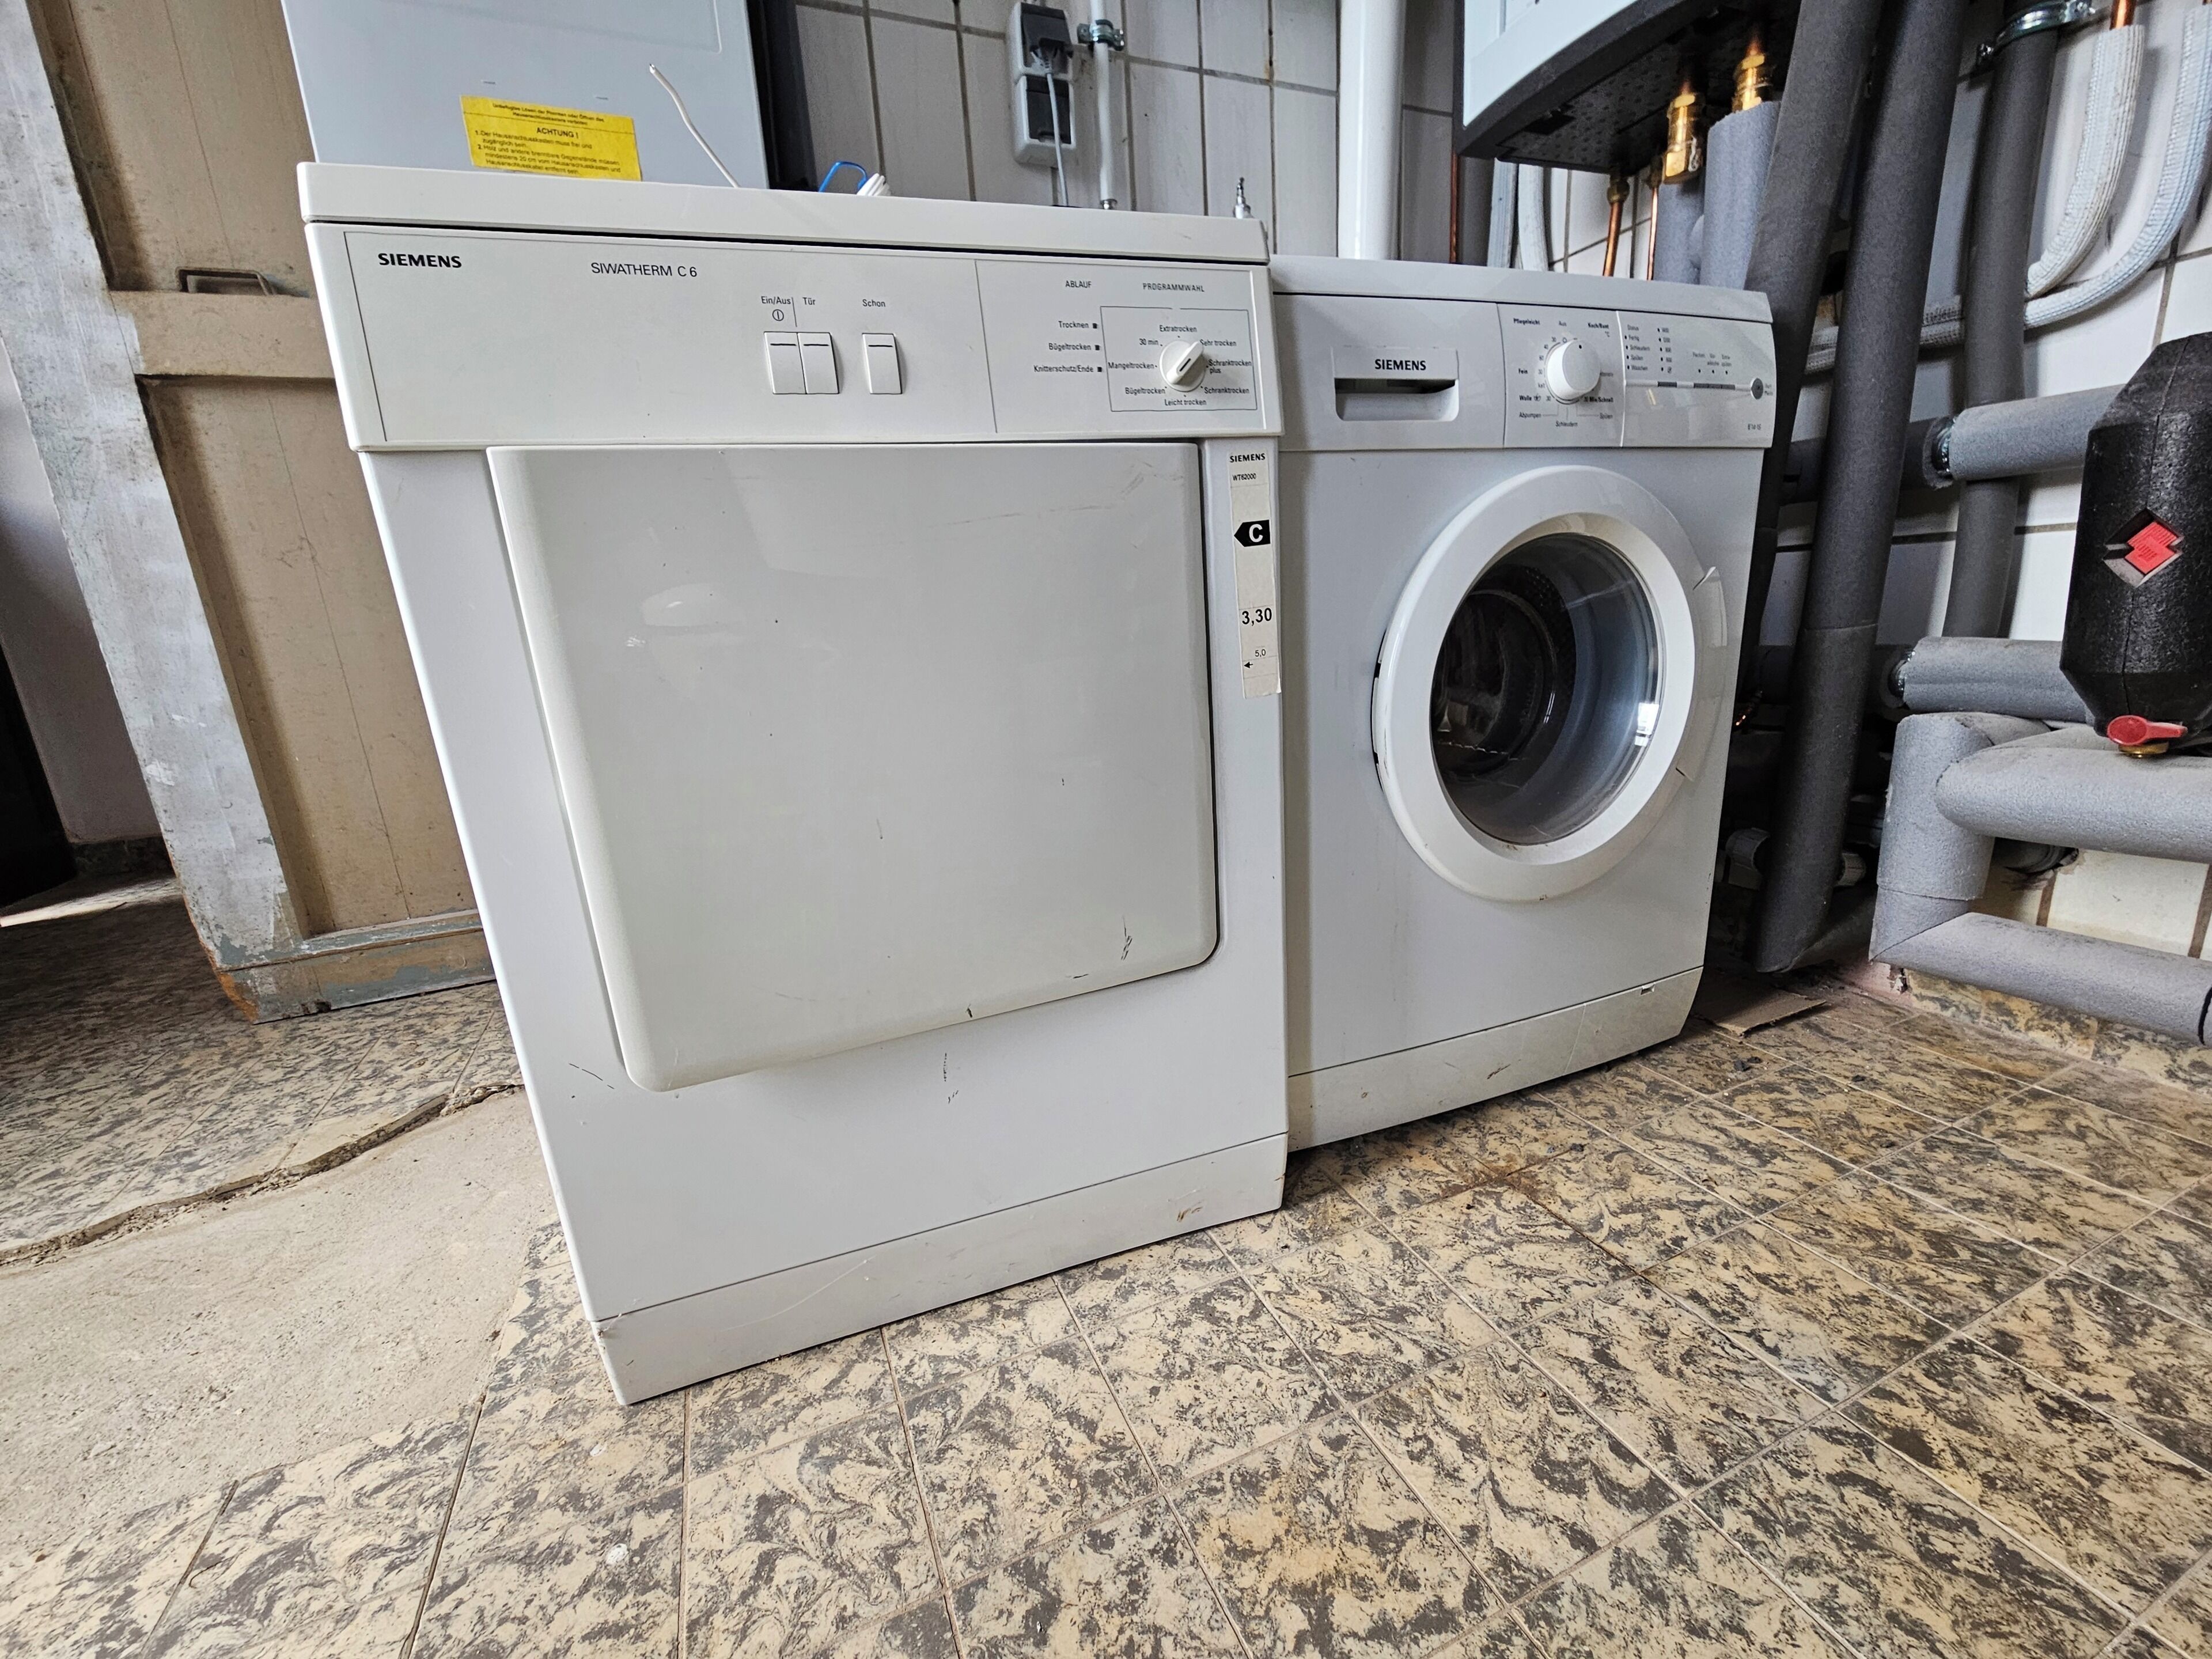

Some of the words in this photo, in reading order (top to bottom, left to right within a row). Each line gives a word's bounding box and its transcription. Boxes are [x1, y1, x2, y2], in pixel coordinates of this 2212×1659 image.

[536, 127, 574, 138] ACHTUNG
[378, 252, 462, 268] SIEMENS
[590, 262, 673, 276] SIWATHERM
[677, 266, 687, 277] C
[690, 266, 697, 278] 6
[1065, 280, 1092, 288] ABLAUF
[1143, 282, 1205, 292] PROGRAMMWAHL
[761, 296, 791, 305] Ein/Aus
[802, 297, 816, 305] Tür
[862, 299, 886, 307] Schon
[1058, 320, 1089, 328] Trocknen
[1159, 324, 1198, 332] Extratrocken
[1048, 342, 1092, 353] Bügeltrocken
[1108, 361, 1154, 370] Mangeltrocken
[1208, 359, 1252, 367] Schranktrocken
[1375, 359, 1426, 370] SIEMENS
[1033, 364, 1094, 373] Knitterschutz/Ende
[1125, 387, 1166, 396] Bügeltrocken
[1204, 387, 1250, 395] Schranktrocken
[1164, 398, 1183, 406] Leicht
[1230, 453, 1266, 463] SIEMENS
[1249, 524, 1263, 543] C
[1242, 608, 1272, 626] 3,30
[1255, 649, 1266, 657] 5,0
